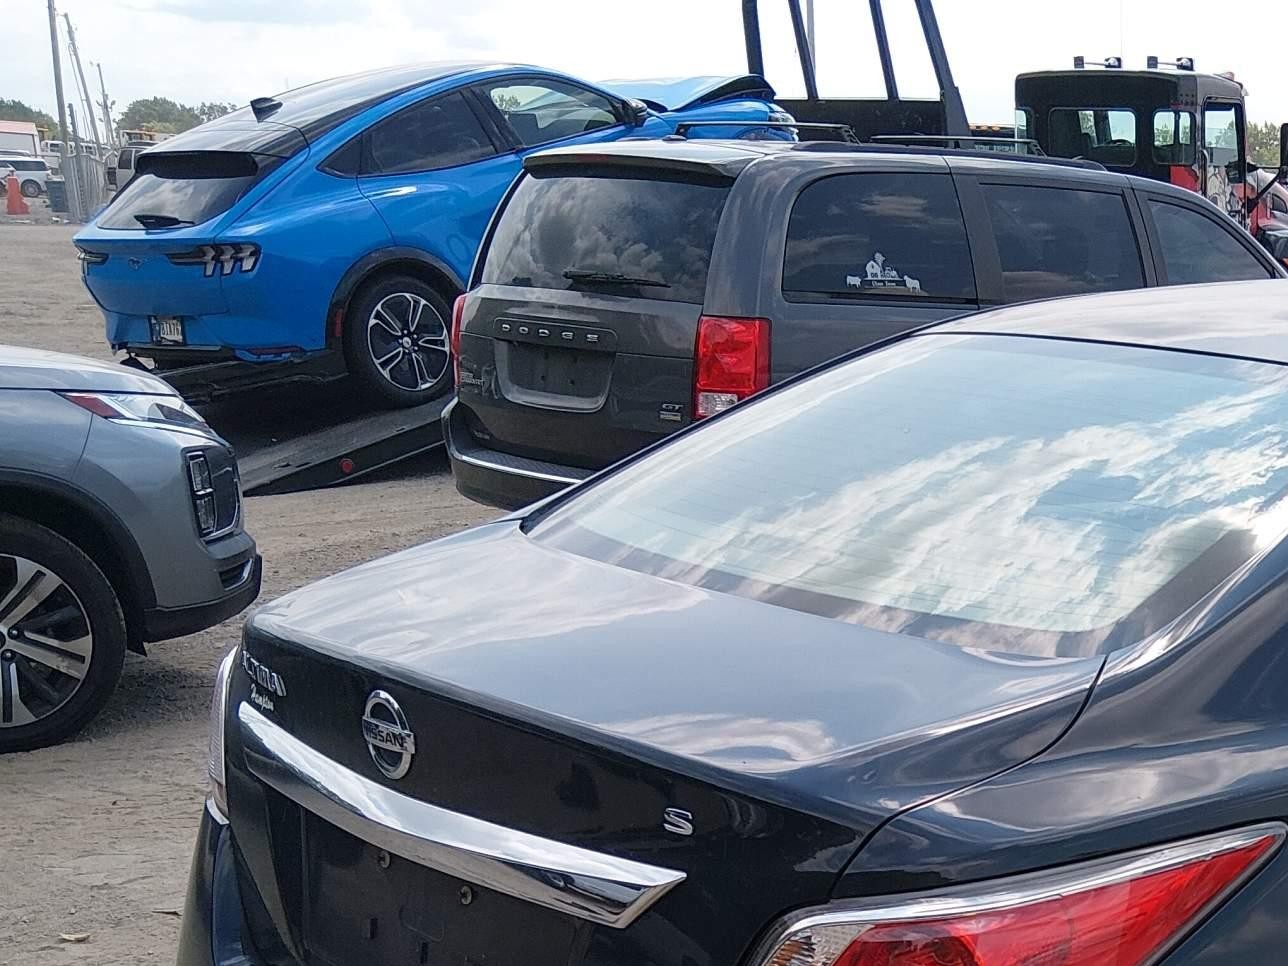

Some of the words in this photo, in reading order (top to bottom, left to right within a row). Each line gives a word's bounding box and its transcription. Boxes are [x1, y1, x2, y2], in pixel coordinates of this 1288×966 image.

[502, 324, 598, 341] DODGE
[364, 721, 404, 748] NISSAN
[664, 808, 692, 835] S
